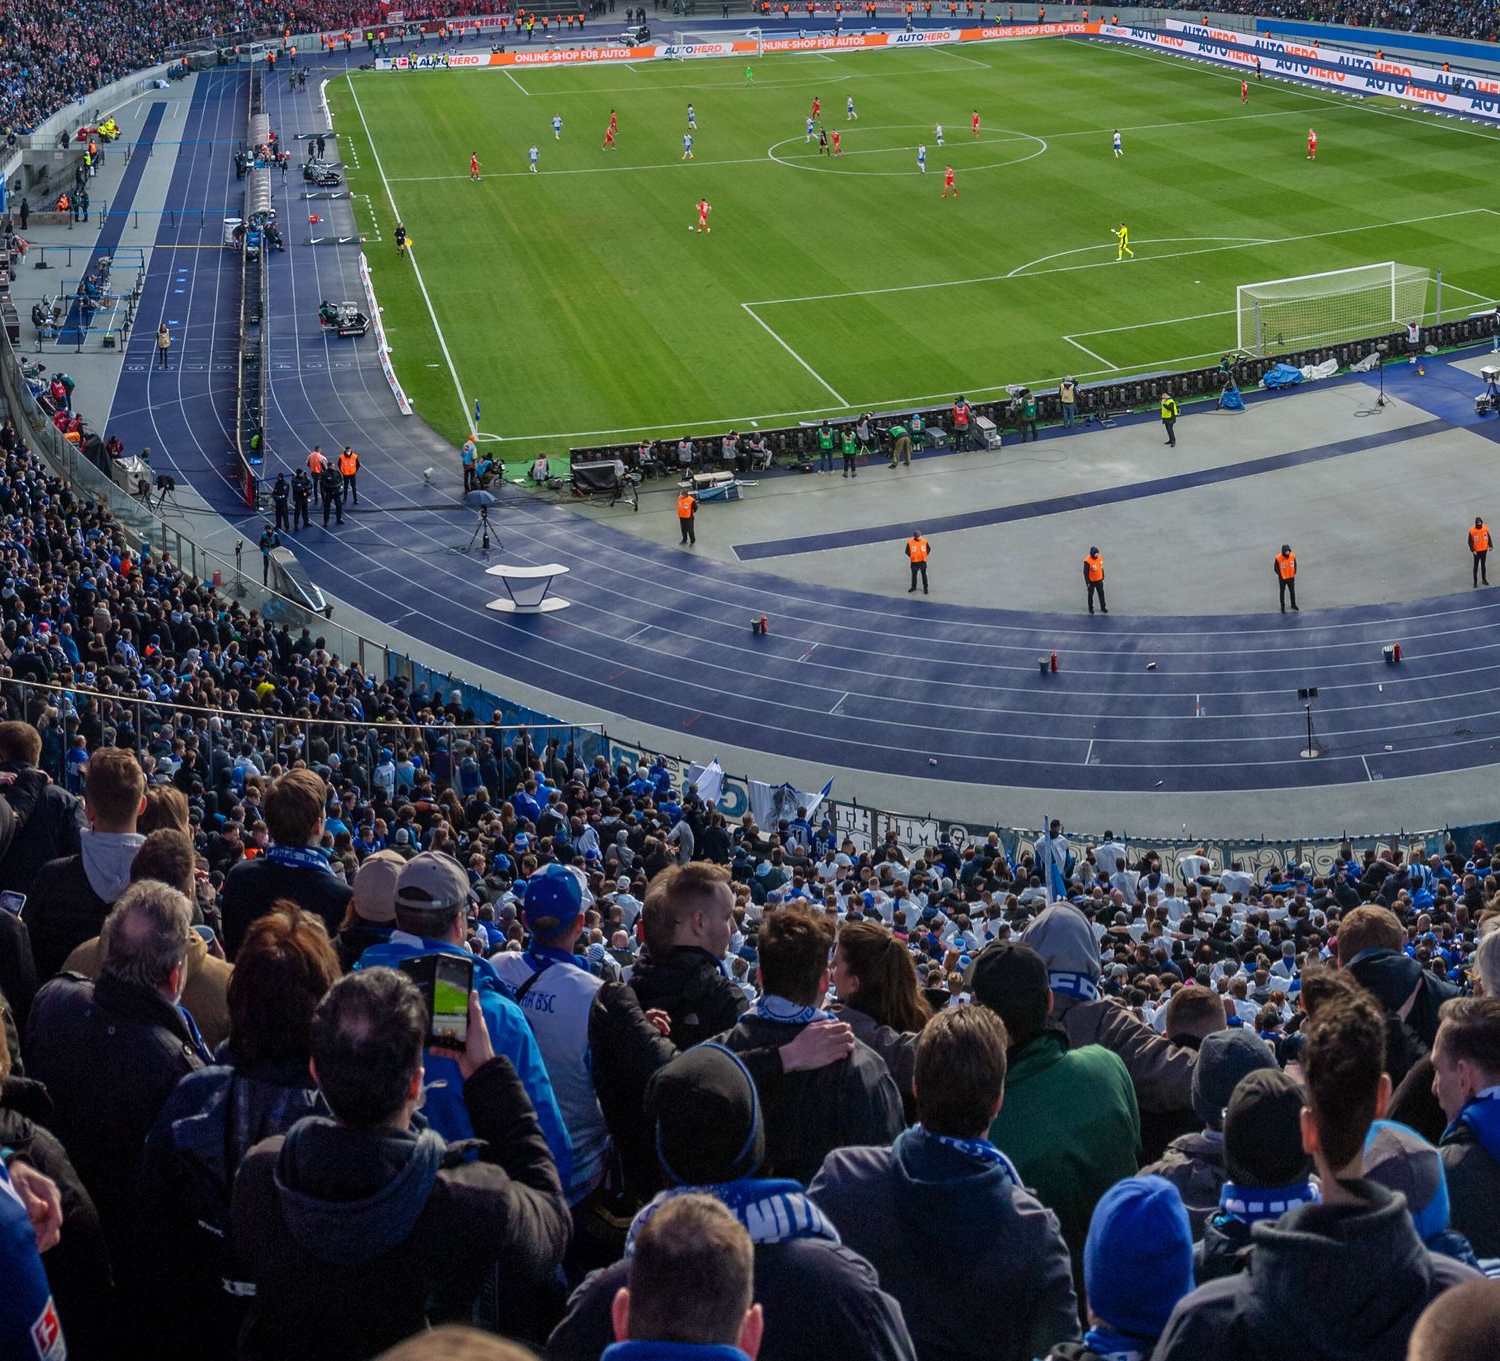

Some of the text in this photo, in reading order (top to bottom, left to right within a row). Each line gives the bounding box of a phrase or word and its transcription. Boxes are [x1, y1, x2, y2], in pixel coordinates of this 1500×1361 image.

[896, 31, 951, 43] AUTOHERO
[982, 23, 1087, 39] ONLINE-SHOP FÜR AUTOS
[756, 36, 867, 49] ONLINE-SHOP FÜR AUTOS
[514, 48, 632, 63] ONLINE-SHOP FÜR AUTOS
[664, 44, 722, 56] AUTOHERO
[536, 993, 556, 1014] BSC
